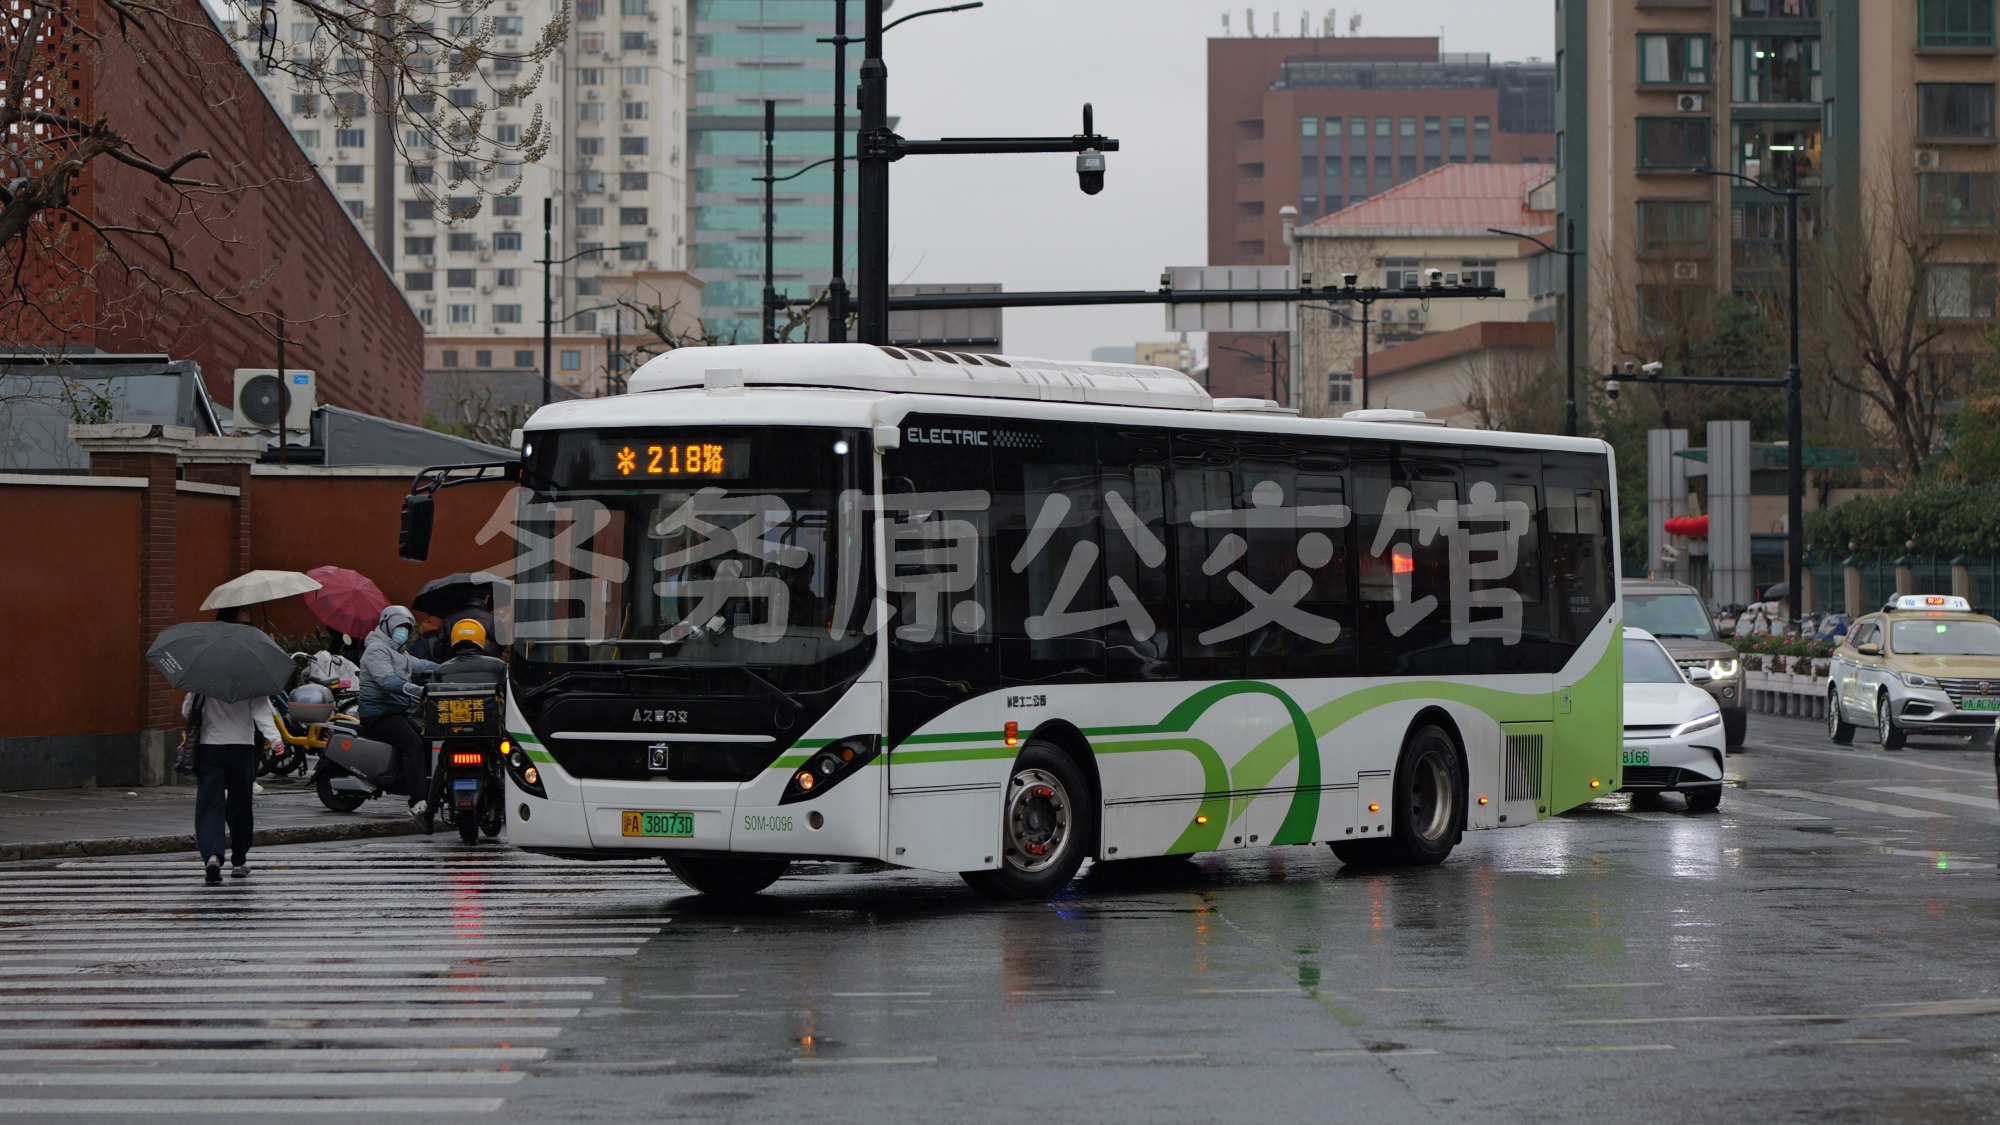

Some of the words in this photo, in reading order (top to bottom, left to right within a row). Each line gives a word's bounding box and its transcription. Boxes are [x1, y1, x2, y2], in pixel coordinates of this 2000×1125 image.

[907, 427, 989, 446] ELECTRIC
[647, 444, 724, 474] 218路
[1623, 751, 1649, 763] 8166
[645, 815, 692, 834] 38073D
